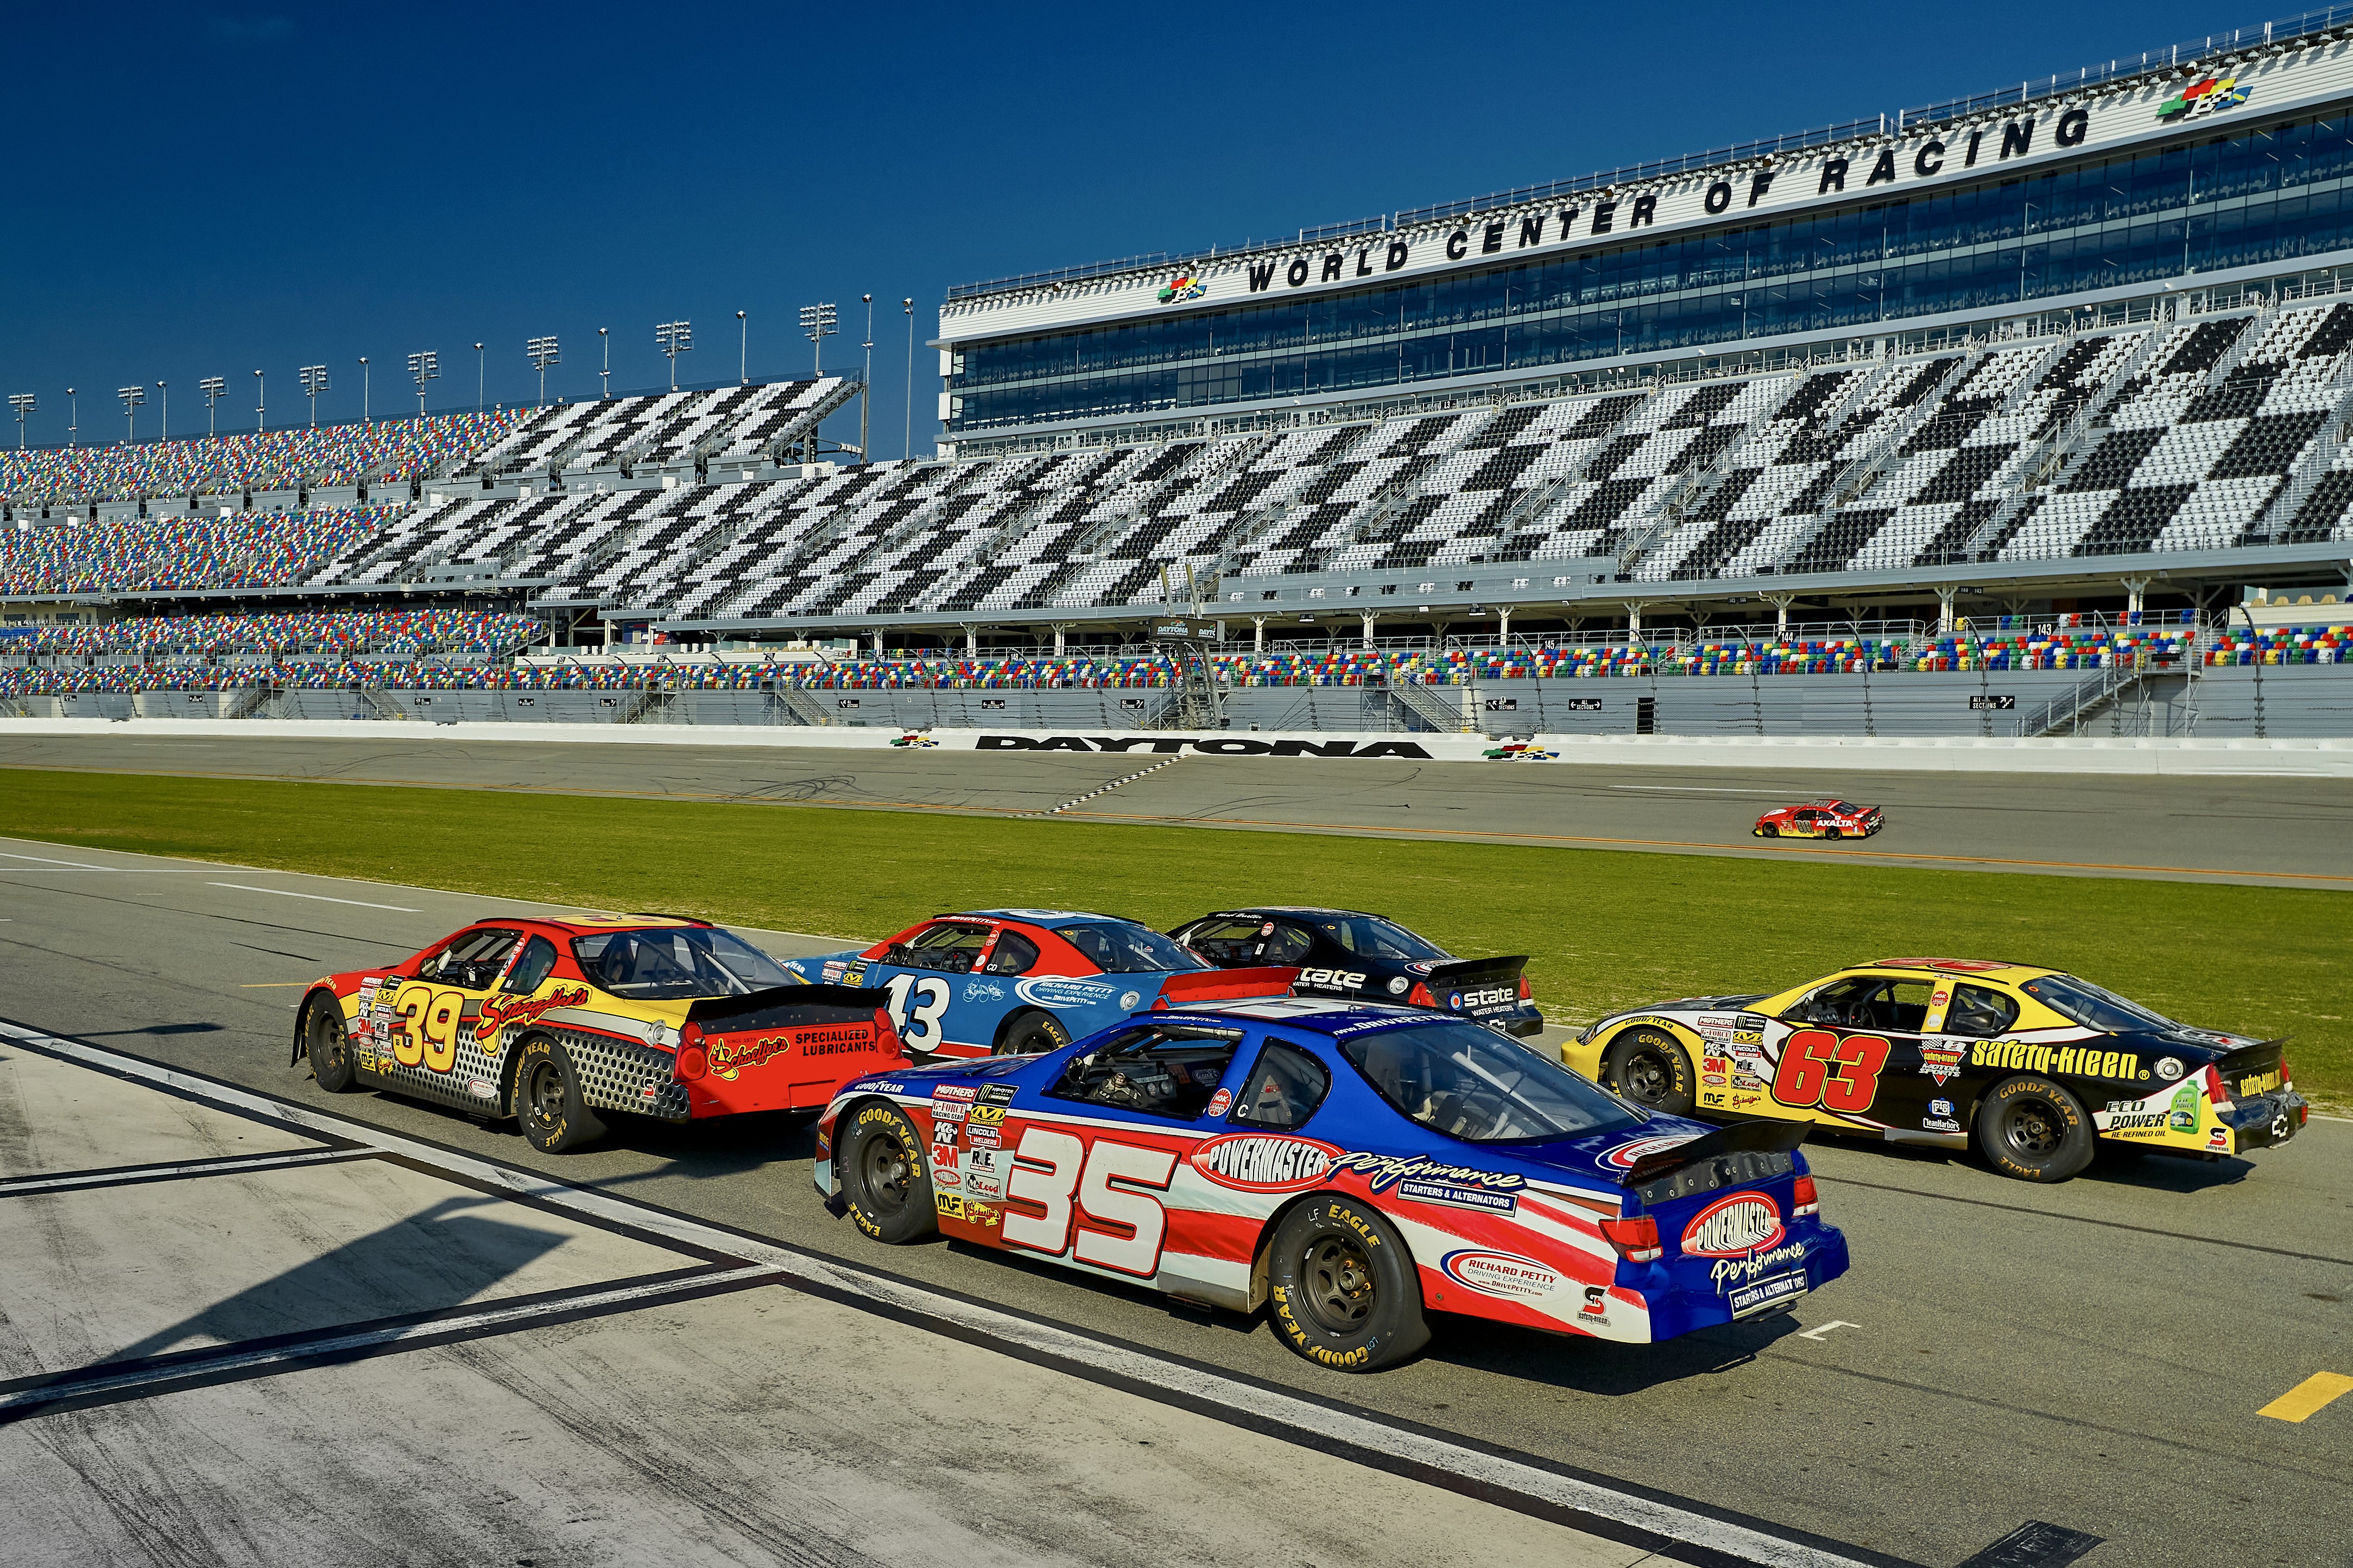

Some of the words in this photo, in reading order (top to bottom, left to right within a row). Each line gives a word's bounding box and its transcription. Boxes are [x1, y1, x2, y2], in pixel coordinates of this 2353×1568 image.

[1249, 242, 1408, 293] WORLD
[1446, 194, 1658, 260] CENTER
[1704, 172, 1775, 214] OF
[1818, 109, 2089, 195] RACING
[1738, 365, 1744, 374] L1
[1578, 385, 1585, 393] L2
[2190, 386, 2205, 397] 347
[1444, 401, 1450, 409] L3
[1694, 413, 1705, 422] 350
[1986, 411, 1998, 420] 348
[1811, 430, 1823, 440] 349
[1157, 626, 1188, 634] DAYTONA
[2038, 624, 2052, 636] 143
[1781, 632, 1793, 643] 144
[1333, 645, 1342, 655] 146
[1545, 640, 1554, 650] 145
[975, 735, 1434, 759] DAYTONA
[1795, 820, 1815, 834] 88
[986, 963, 998, 972] CD
[1295, 967, 1367, 989] tate
[1035, 986, 1064, 994] DRIVING
[1064, 989, 1110, 1000] EXPERIENCE
[1039, 981, 1084, 991] RICHARD
[1084, 985, 1116, 994] PETTY
[1314, 983, 1343, 991] HEATERS
[1464, 987, 1514, 1007] state
[477, 987, 589, 1040] Schaeffer's
[1471, 1007, 1492, 1017] WATER
[1492, 1005, 1514, 1013] HEATERS
[358, 1018, 371, 1034] 3M
[1624, 1016, 1674, 1030] GOODYEAR
[1699, 1017, 1735, 1025] MOTHERS
[393, 986, 465, 1073] 39
[795, 1029, 869, 1044] SPECIALIZED
[1702, 1029, 1730, 1038] G-FORCE
[802, 1040, 875, 1056] LUBRICANTS
[710, 1037, 788, 1075] Schaeffer's
[1638, 1034, 1684, 1093] GOODYEAR
[1703, 1058, 1726, 1074] 3M
[1772, 1027, 1892, 1113] 63
[1922, 1063, 1960, 1072] MOTOR
[1919, 1068, 1961, 1077] SPORTS
[855, 1080, 904, 1094] GOODYEAR
[935, 1085, 976, 1097] MOTHERS
[1214, 1095, 1228, 1103] NGK
[1999, 1081, 2079, 1126] GOODYEAR
[933, 1100, 966, 1114] G-FORCE
[1237, 1104, 1249, 1118] C
[1933, 1102, 1949, 1113] pig
[2105, 1100, 2146, 1113] ECO
[932, 1110, 950, 1119] RACING
[2109, 1112, 2168, 1130] POWER
[545, 1118, 568, 1147] EAGLE
[968, 1126, 996, 1138] LINCOLN
[858, 1107, 921, 1178] GOODYEAR
[973, 1137, 997, 1146] WELDERS
[933, 1145, 959, 1169] 3M
[1208, 1138, 1329, 1183] POWERMASTER
[1326, 1152, 1523, 1190] Performance
[1997, 1156, 2041, 1178] EAGLE
[968, 1178, 998, 1193] McLeod
[1000, 1123, 1181, 1281] 35
[1403, 1183, 1443, 1197] STARTERS
[1444, 1189, 1450, 1198] &
[1452, 1190, 1510, 1208] ALTERNATORS
[967, 1202, 1001, 1220] Schaeffer's
[848, 1201, 881, 1237] EAGLE
[1328, 1204, 1381, 1248] EAGLE
[1696, 1201, 1775, 1252] POWERMASTER
[1468, 1259, 1518, 1276] RICHARD
[1520, 1269, 1557, 1284] PETTY
[1710, 1242, 1805, 1295] Performance
[1467, 1268, 1501, 1280] DRIVING
[1502, 1275, 1555, 1292] EXPERIENCE
[1759, 1289, 1765, 1299] &
[1273, 1285, 1369, 1367] GOODYEAR
